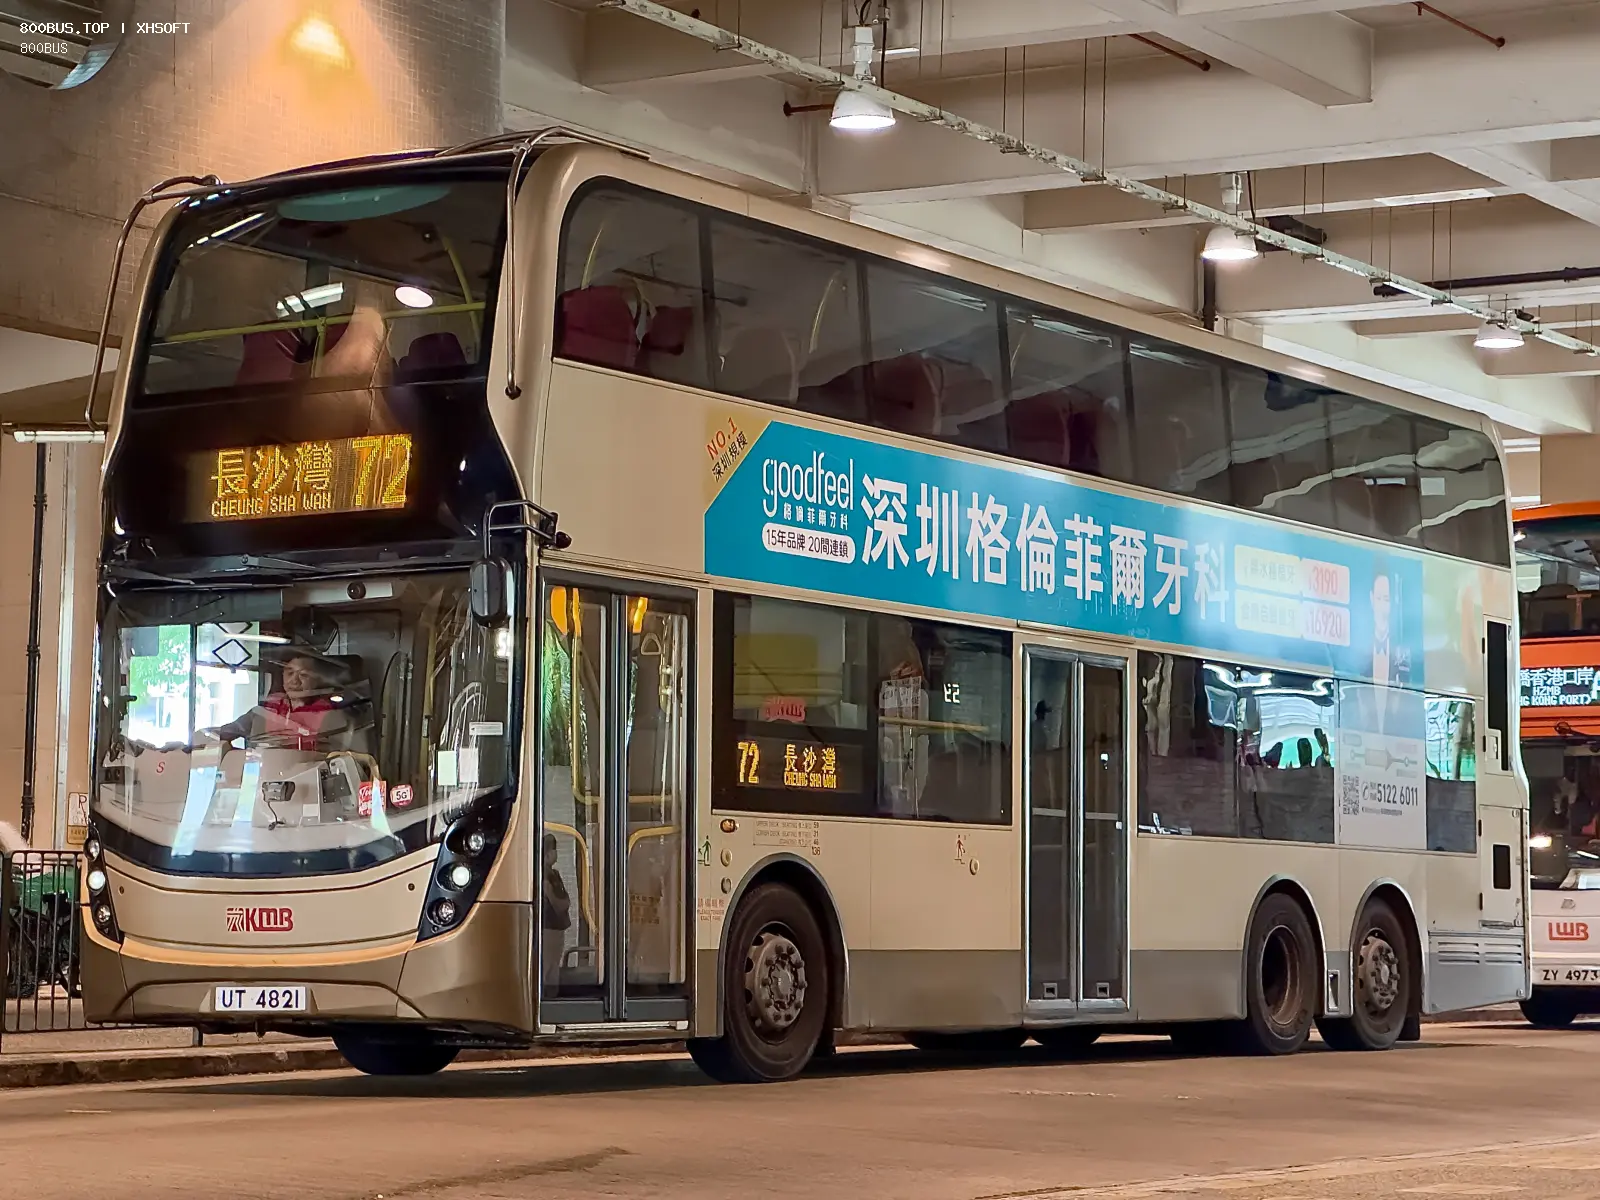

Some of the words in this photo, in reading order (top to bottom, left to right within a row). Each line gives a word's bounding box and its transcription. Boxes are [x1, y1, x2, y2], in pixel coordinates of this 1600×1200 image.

[706, 417, 738, 460] NO.1
[211, 441, 333, 498] 長沙灣
[711, 431, 748, 482] 深圳規模
[352, 435, 412, 506] 72
[763, 450, 854, 517] goodfeel
[211, 498, 263, 517] CHEUNG
[269, 494, 297, 513] SHA
[303, 491, 332, 510] WAN
[783, 502, 849, 530] 格倫菲爾牙科
[766, 529, 806, 551] 15年品牌
[808, 535, 849, 558] 20間連鎖
[860, 473, 1226, 623] 深圳格倫菲爾牙科
[1531, 695, 1557, 706] KONG
[1533, 686, 1561, 696] HZMB
[738, 742, 759, 783] 72
[784, 744, 836, 774] 長沙灣
[784, 771, 808, 786] CHEUNG
[809, 773, 822, 788] SHA
[395, 790, 408, 801] 5G
[1377, 783, 1397, 805] 5122
[1399, 786, 1418, 806] 6011
[245, 907, 294, 932] KMB
[1548, 922, 1590, 941] LWB
[1542, 969, 1559, 981] ZY
[1565, 969, 1599, 981] 4973
[221, 989, 247, 1009] UT
[256, 989, 299, 1009] 4821
